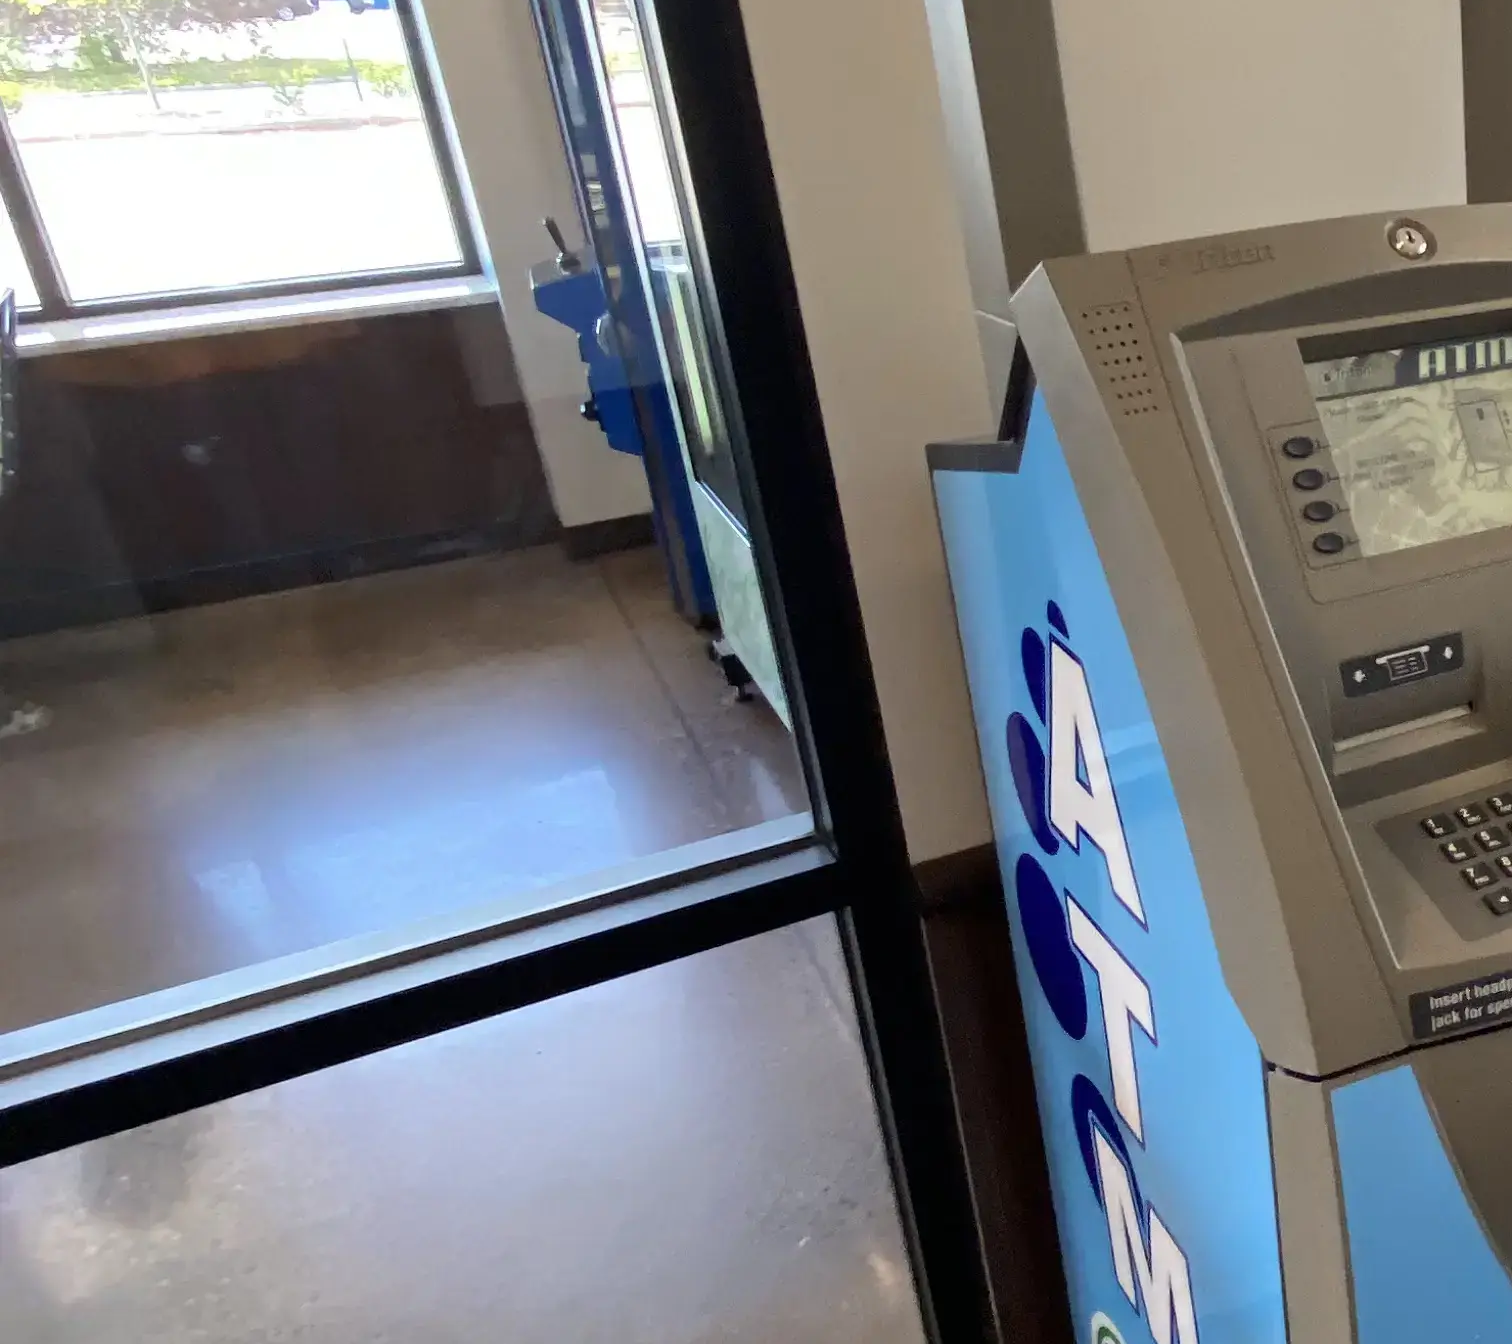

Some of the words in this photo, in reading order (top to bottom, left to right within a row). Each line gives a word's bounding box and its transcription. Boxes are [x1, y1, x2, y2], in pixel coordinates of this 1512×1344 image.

[1459, 808, 1470, 818] 2
[1429, 987, 1472, 1010] Insert
[1431, 1010, 1461, 1032] jack
[1464, 1005, 1483, 1020] for
